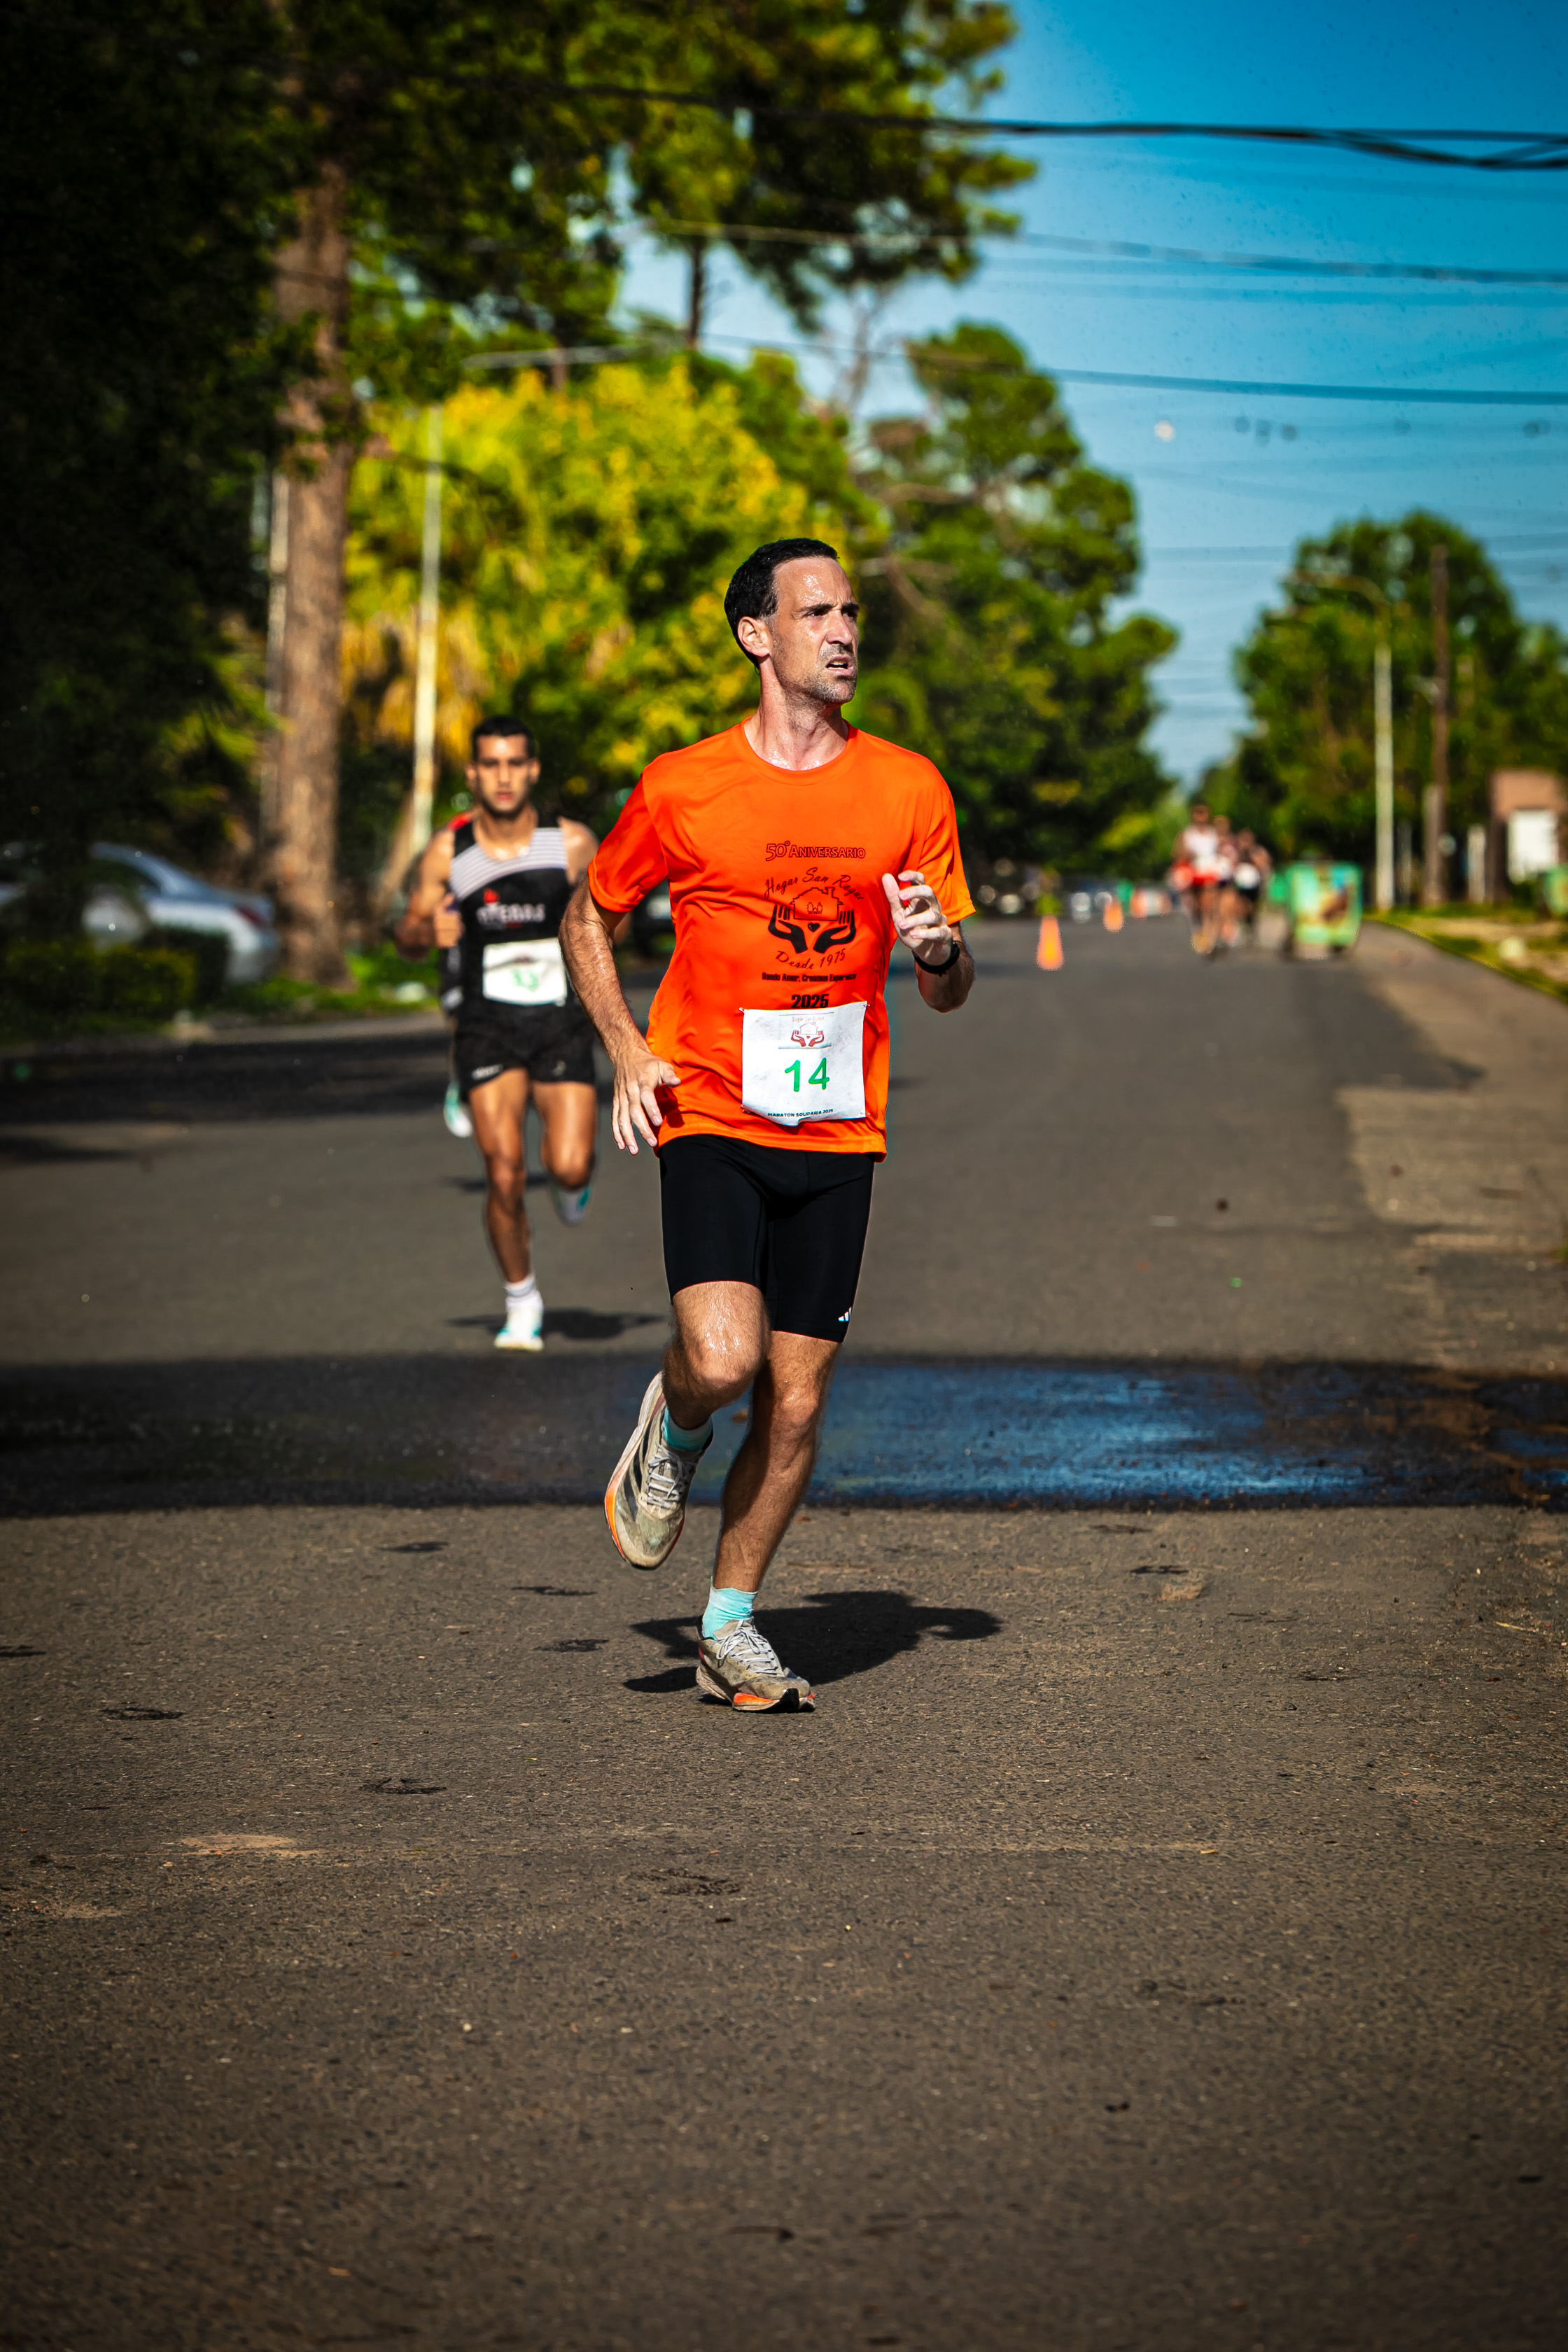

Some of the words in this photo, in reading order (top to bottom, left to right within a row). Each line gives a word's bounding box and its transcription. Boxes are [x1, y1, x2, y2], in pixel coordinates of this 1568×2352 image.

[788, 844, 866, 859] ANIVERSARIO
[764, 877, 798, 899] Hogar
[802, 867, 829, 883] San
[832, 874, 865, 899] Roque
[776, 950, 814, 969] Desde
[820, 948, 846, 968] 1975
[790, 994, 830, 1009] 2025
[784, 1057, 830, 1092] 14
